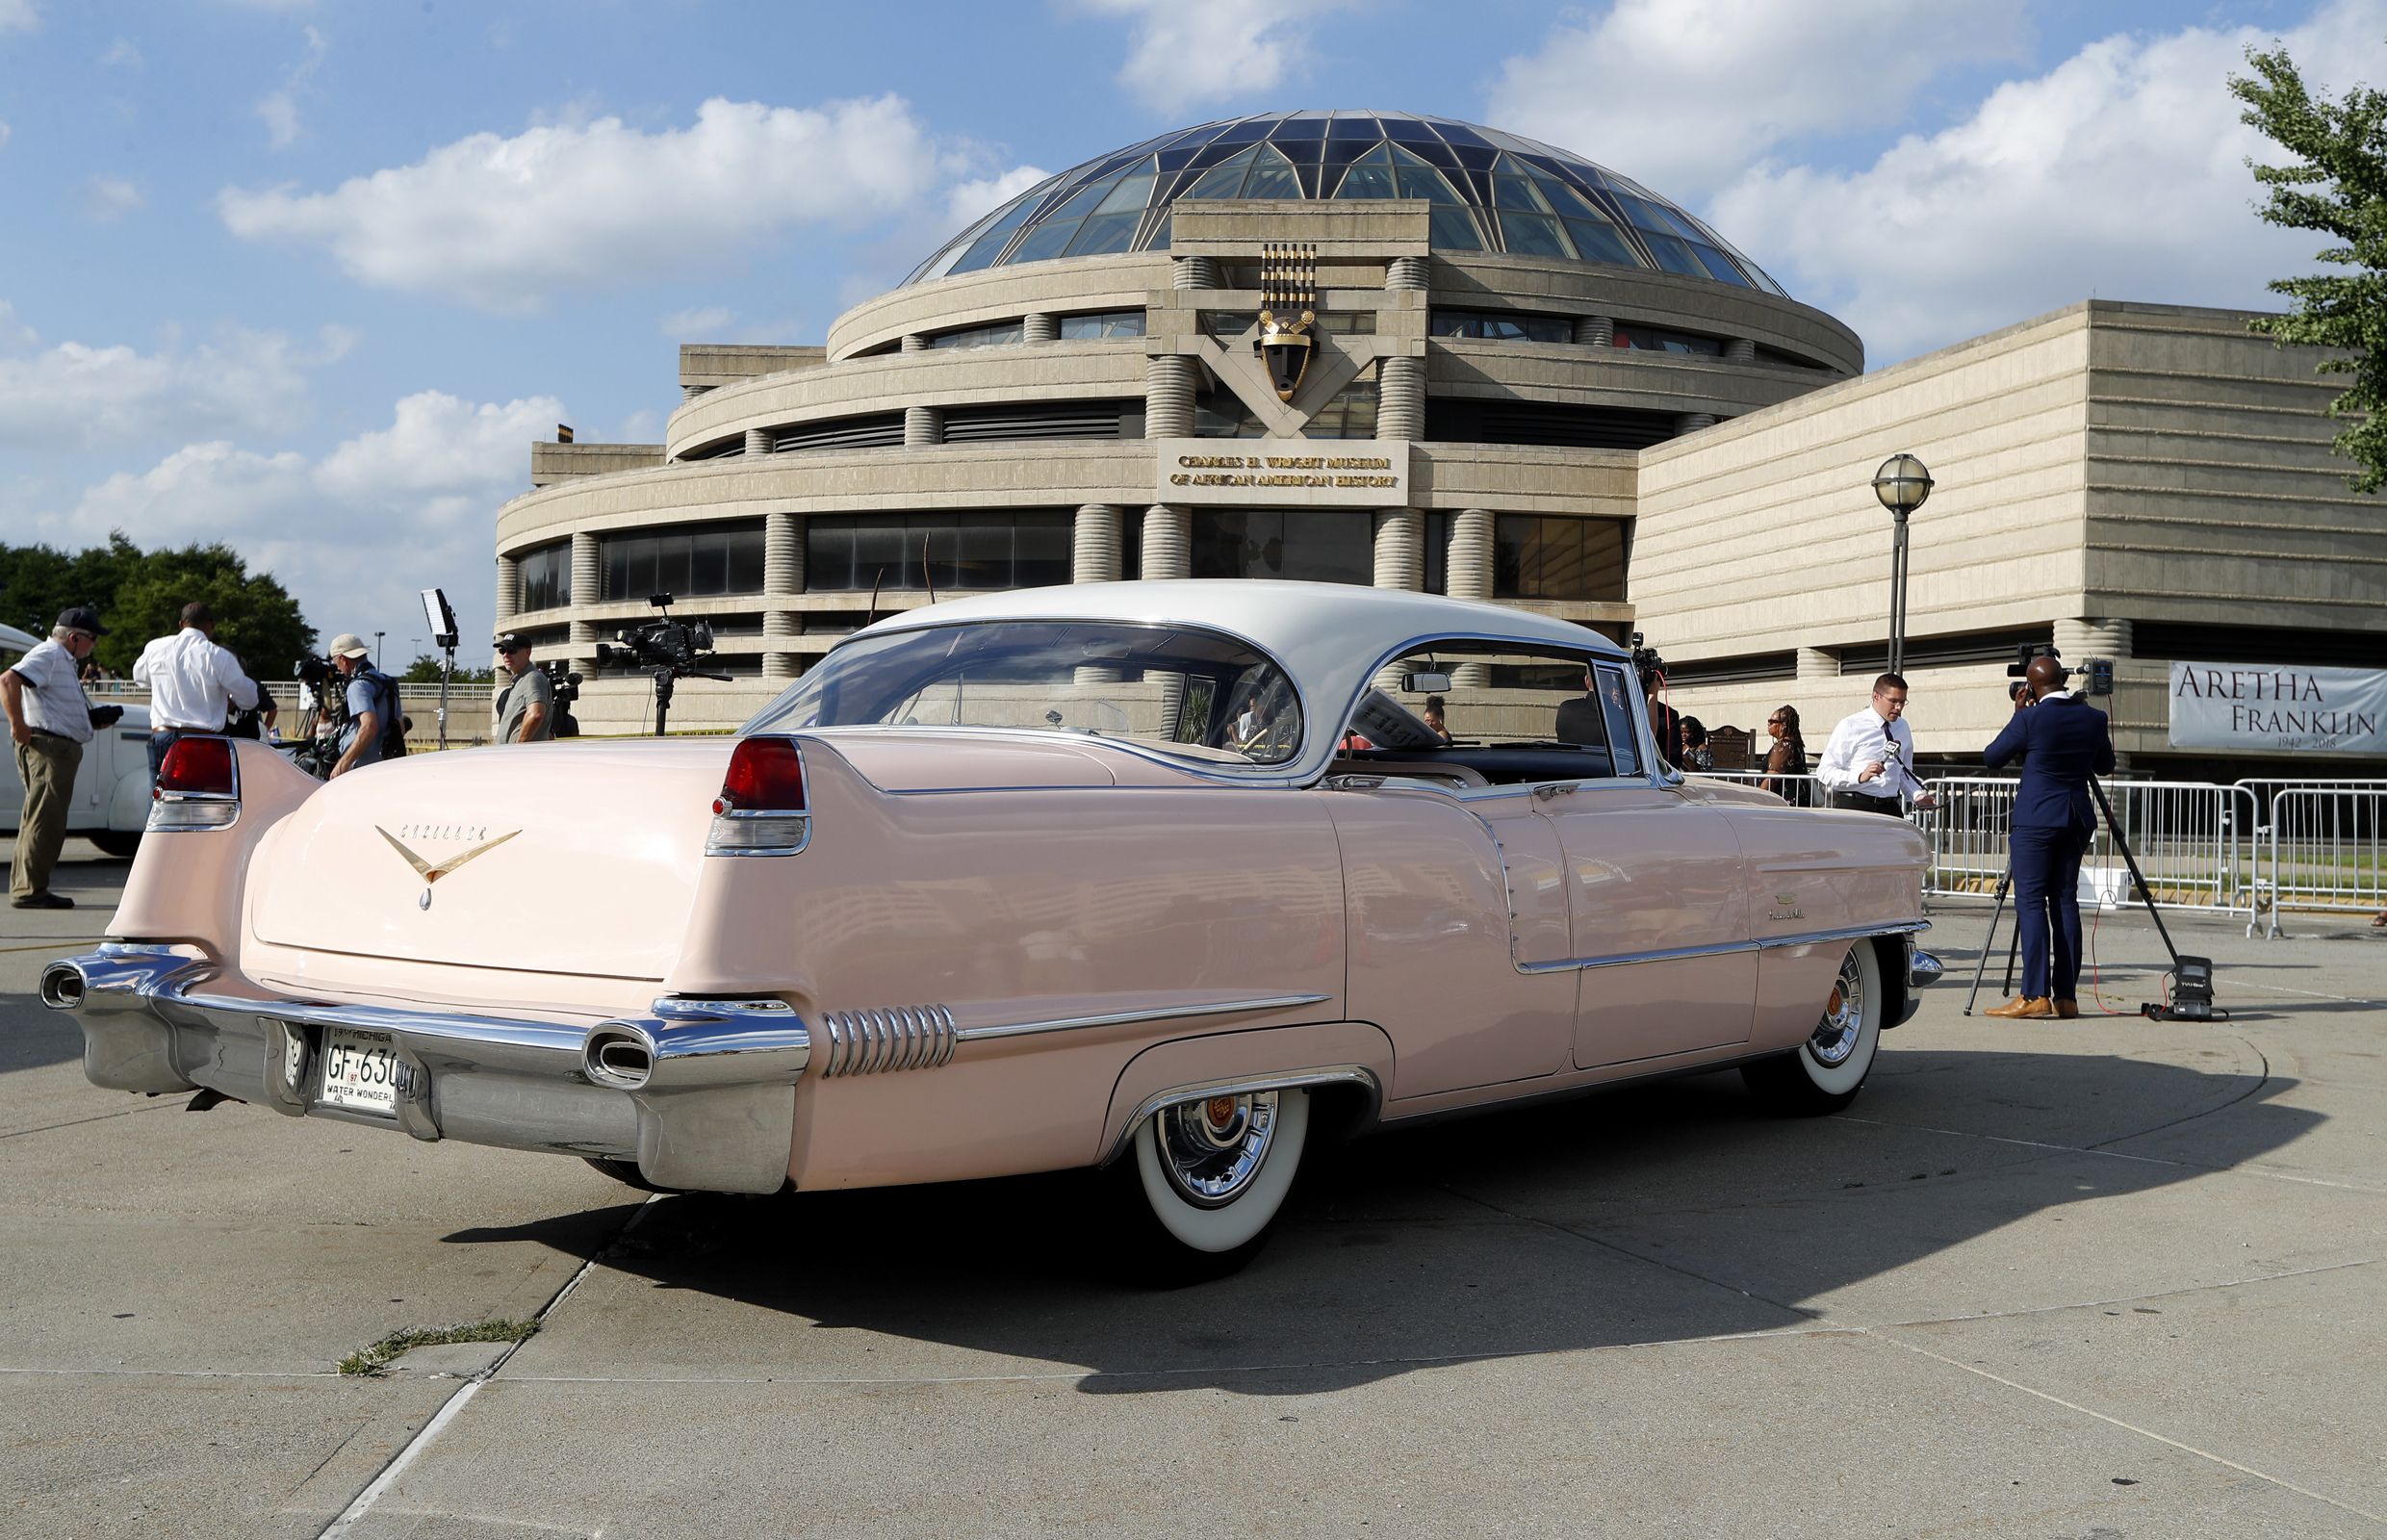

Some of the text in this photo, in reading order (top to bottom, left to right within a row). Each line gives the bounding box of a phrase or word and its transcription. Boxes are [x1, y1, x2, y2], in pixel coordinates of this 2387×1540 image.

[1178, 455, 1391, 470] CHARLES H. WRIGHT MUSEUM
[1169, 474, 1399, 488] OF AFRICAN AMERICAN HISTORY
[2176, 664, 2324, 702] ARETHA
[2231, 705, 2376, 735] FRANKLIN
[2278, 736, 2302, 749] 1942
[2312, 737, 2337, 749] 2018
[352, 1030, 393, 1042] MICHIGA
[327, 1084, 394, 1102] WATER WONDERL
